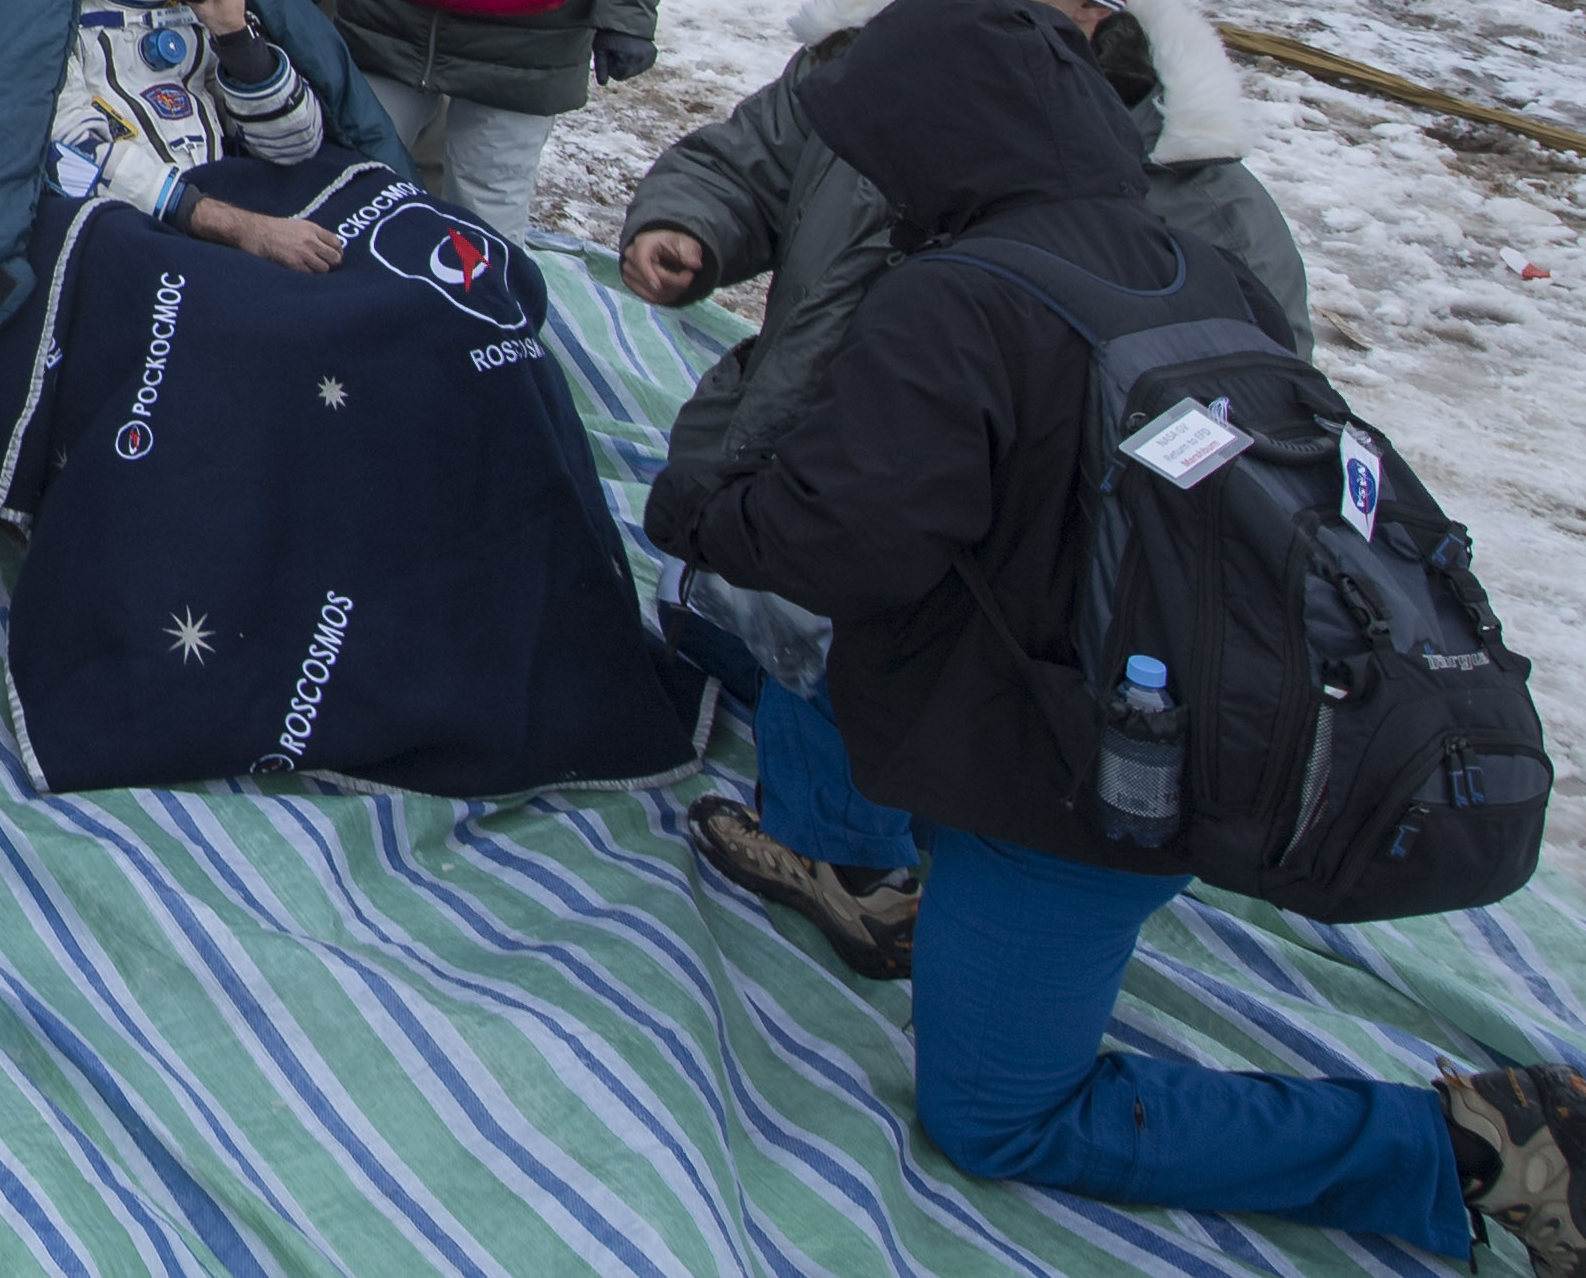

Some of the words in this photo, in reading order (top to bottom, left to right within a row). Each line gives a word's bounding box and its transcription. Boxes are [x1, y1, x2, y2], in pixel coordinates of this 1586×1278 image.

[132, 272, 187, 417] РОСКОСМОС
[1156, 430, 1181, 448] NASA
[1162, 442, 1187, 462] Return
[1356, 465, 1369, 508] NASA
[279, 590, 354, 756] ROSCOSMOS
